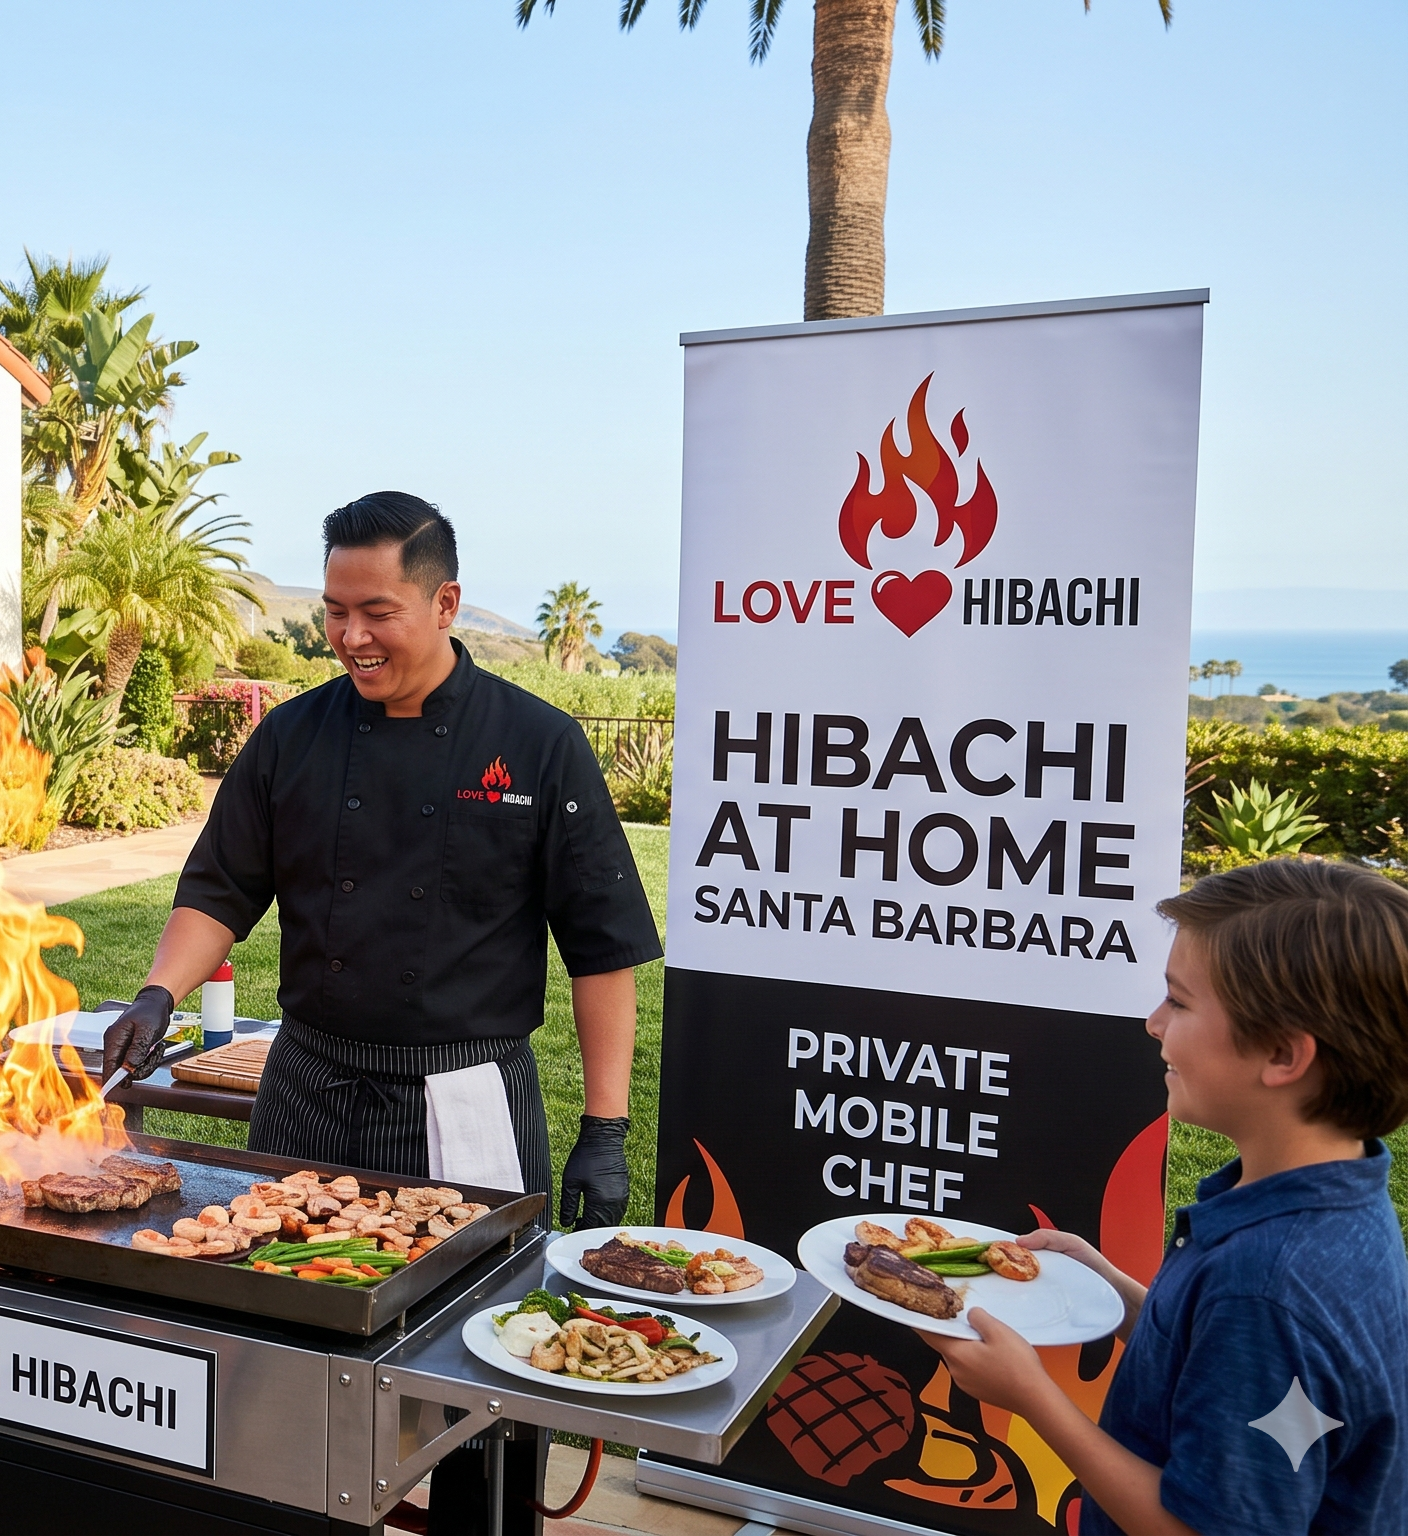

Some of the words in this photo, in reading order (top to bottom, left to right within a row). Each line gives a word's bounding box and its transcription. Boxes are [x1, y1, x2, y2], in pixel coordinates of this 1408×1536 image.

[713, 580, 855, 625] LOVE
[962, 577, 1140, 626] HIBACHI
[712, 710, 1128, 803] HIBACHI
[457, 789, 485, 800] LOVE
[694, 800, 811, 873] AT
[839, 807, 1135, 901] HOME
[693, 885, 856, 936] SANTA
[871, 900, 1138, 963] BARBARA
[787, 1027, 1010, 1097] PRIVATE
[794, 1088, 999, 1158] MOBILE
[822, 1154, 964, 1212] CHEF
[12, 1353, 176, 1430] HIBACHI
